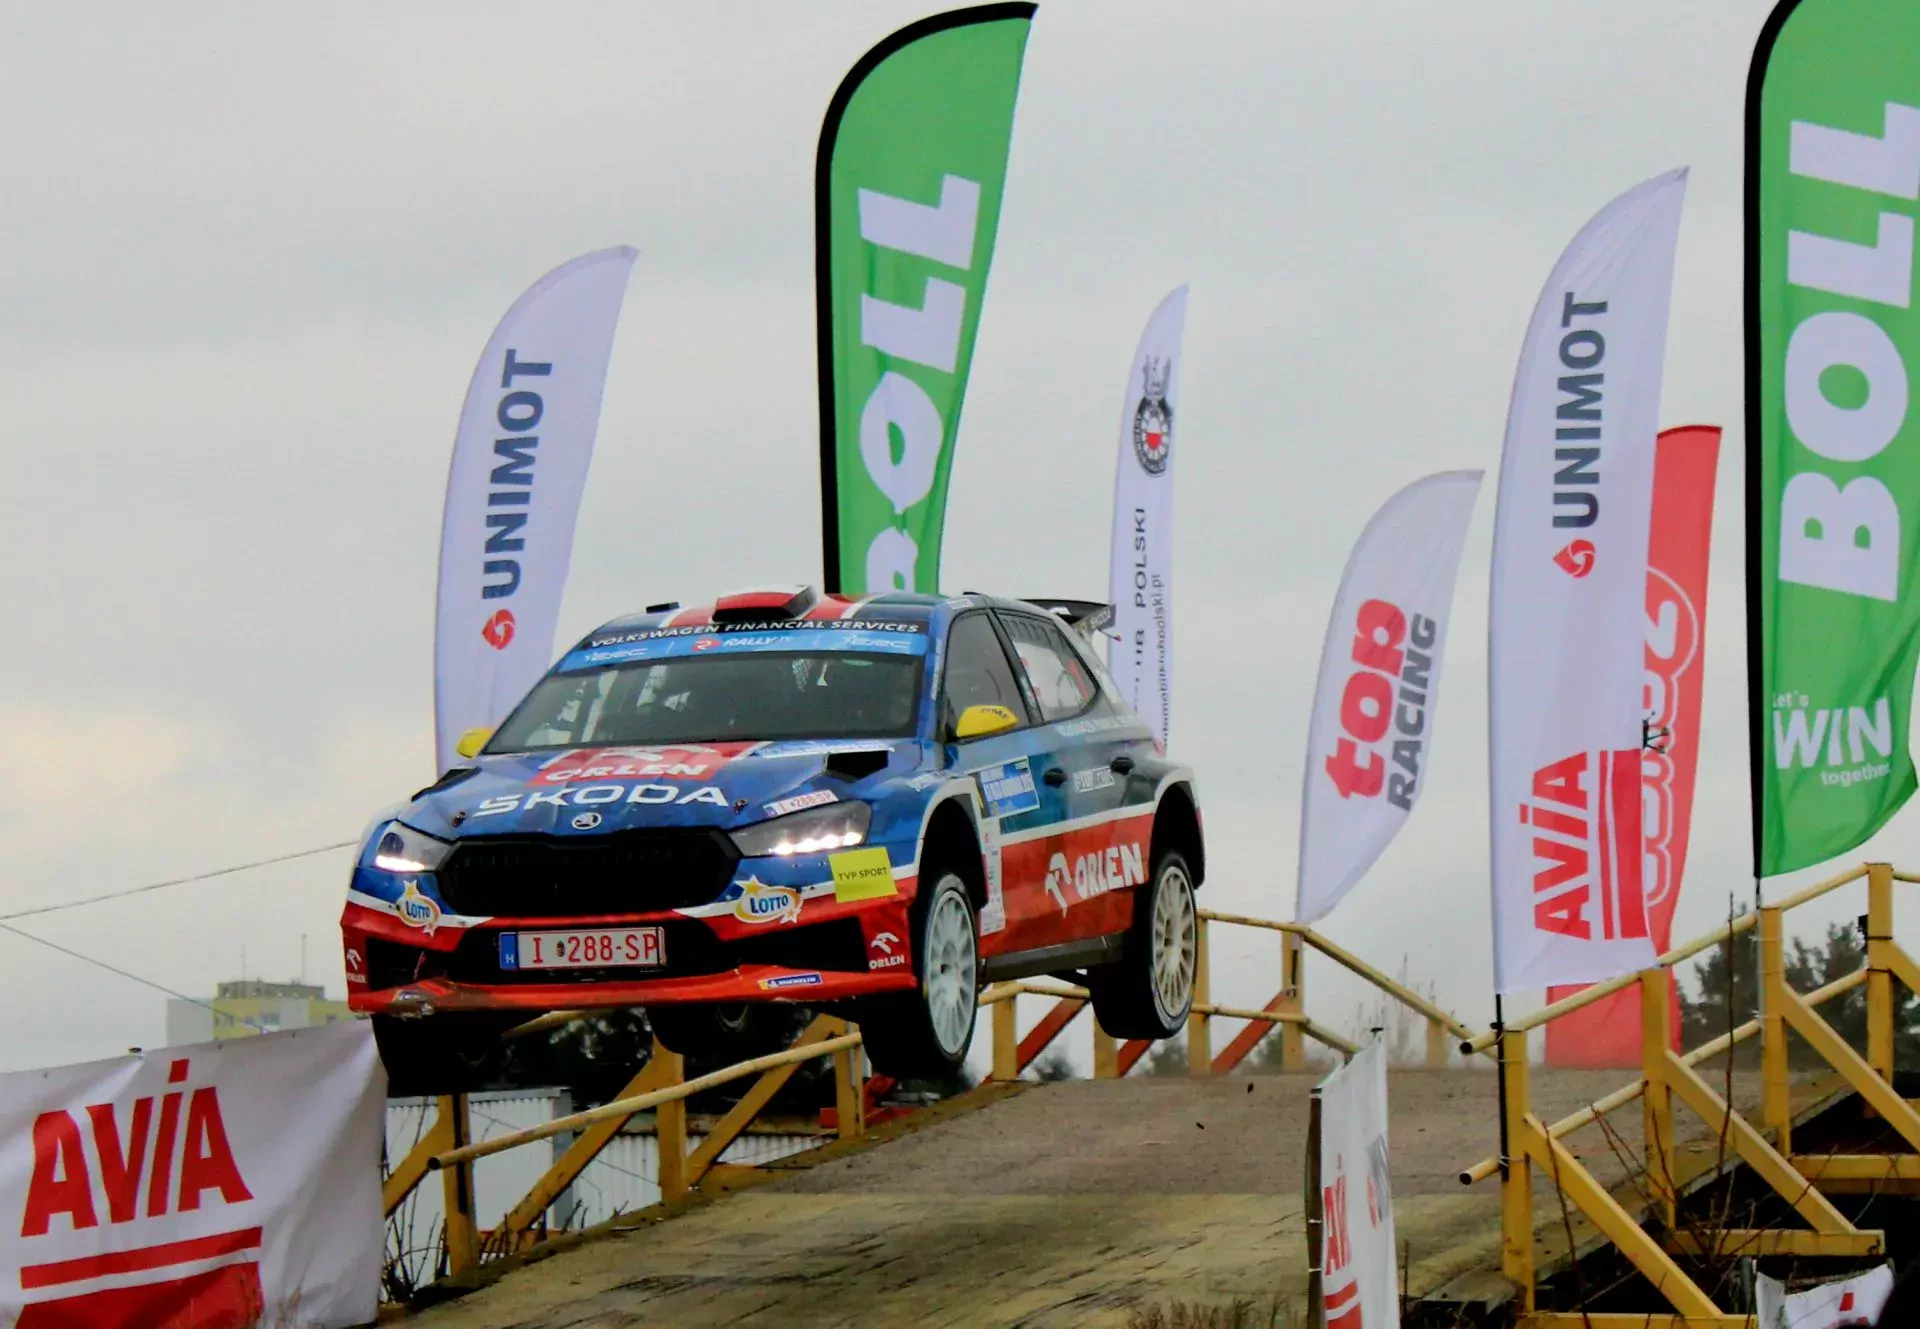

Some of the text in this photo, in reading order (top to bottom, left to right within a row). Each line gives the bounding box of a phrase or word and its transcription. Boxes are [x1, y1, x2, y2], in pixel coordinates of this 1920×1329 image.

[1778, 101, 1920, 603] BOLL
[1552, 291, 1608, 528] UNIMOT
[482, 348, 552, 599] UNIMOT
[1134, 507, 1147, 609] POLSKI
[592, 620, 920, 648] VOLKSWAGEN FINANCIAL SERVICES
[723, 636, 777, 648] RALLY
[1325, 598, 1407, 800] top
[1387, 612, 1436, 812] RACING
[1773, 698, 1892, 769] WIN
[546, 763, 707, 781] ORLEN
[472, 784, 729, 818] SKODA
[838, 867, 888, 881] TVP SPORT
[1075, 842, 1144, 900] ORLEN
[405, 901, 431, 919] LOTTO
[750, 894, 789, 914] LOTTO
[505, 954, 514, 963] H
[568, 933, 658, 963] 288-SP
[869, 954, 905, 969] ORLEN
